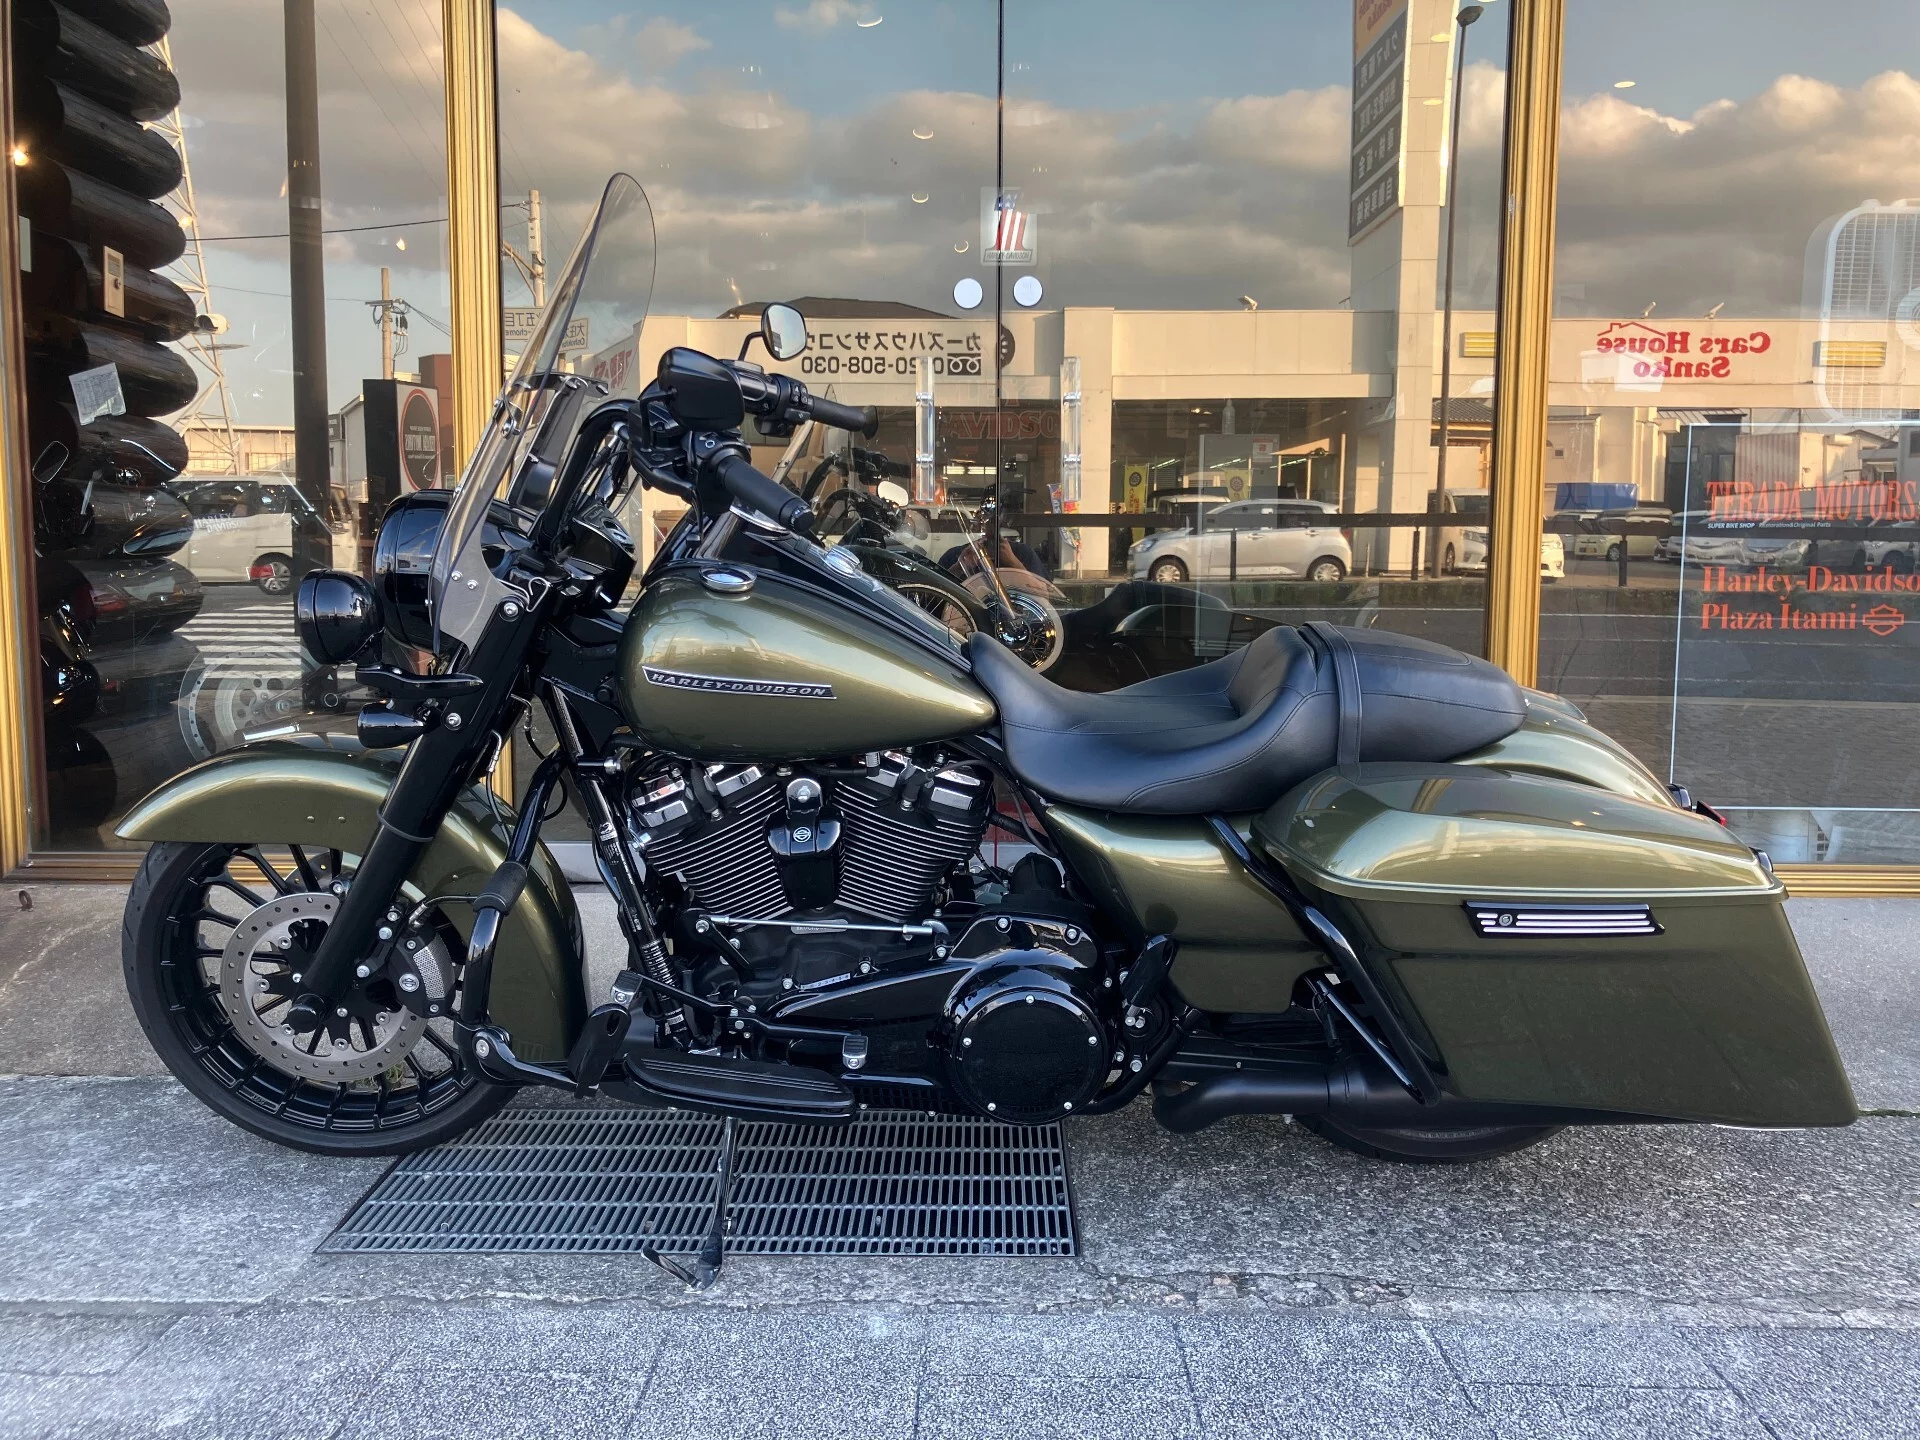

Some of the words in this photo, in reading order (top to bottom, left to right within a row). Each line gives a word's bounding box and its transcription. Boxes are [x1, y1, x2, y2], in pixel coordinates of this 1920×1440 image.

[941, 411, 1061, 440] AVIDSO
[1706, 481, 1802, 521] TERADA
[1702, 565, 1920, 602] Harley-Davidso
[1701, 604, 1773, 630] Plaza
[1779, 603, 1857, 630] Itami
[652, 673, 826, 696] HARLEY-DAVIDSON
